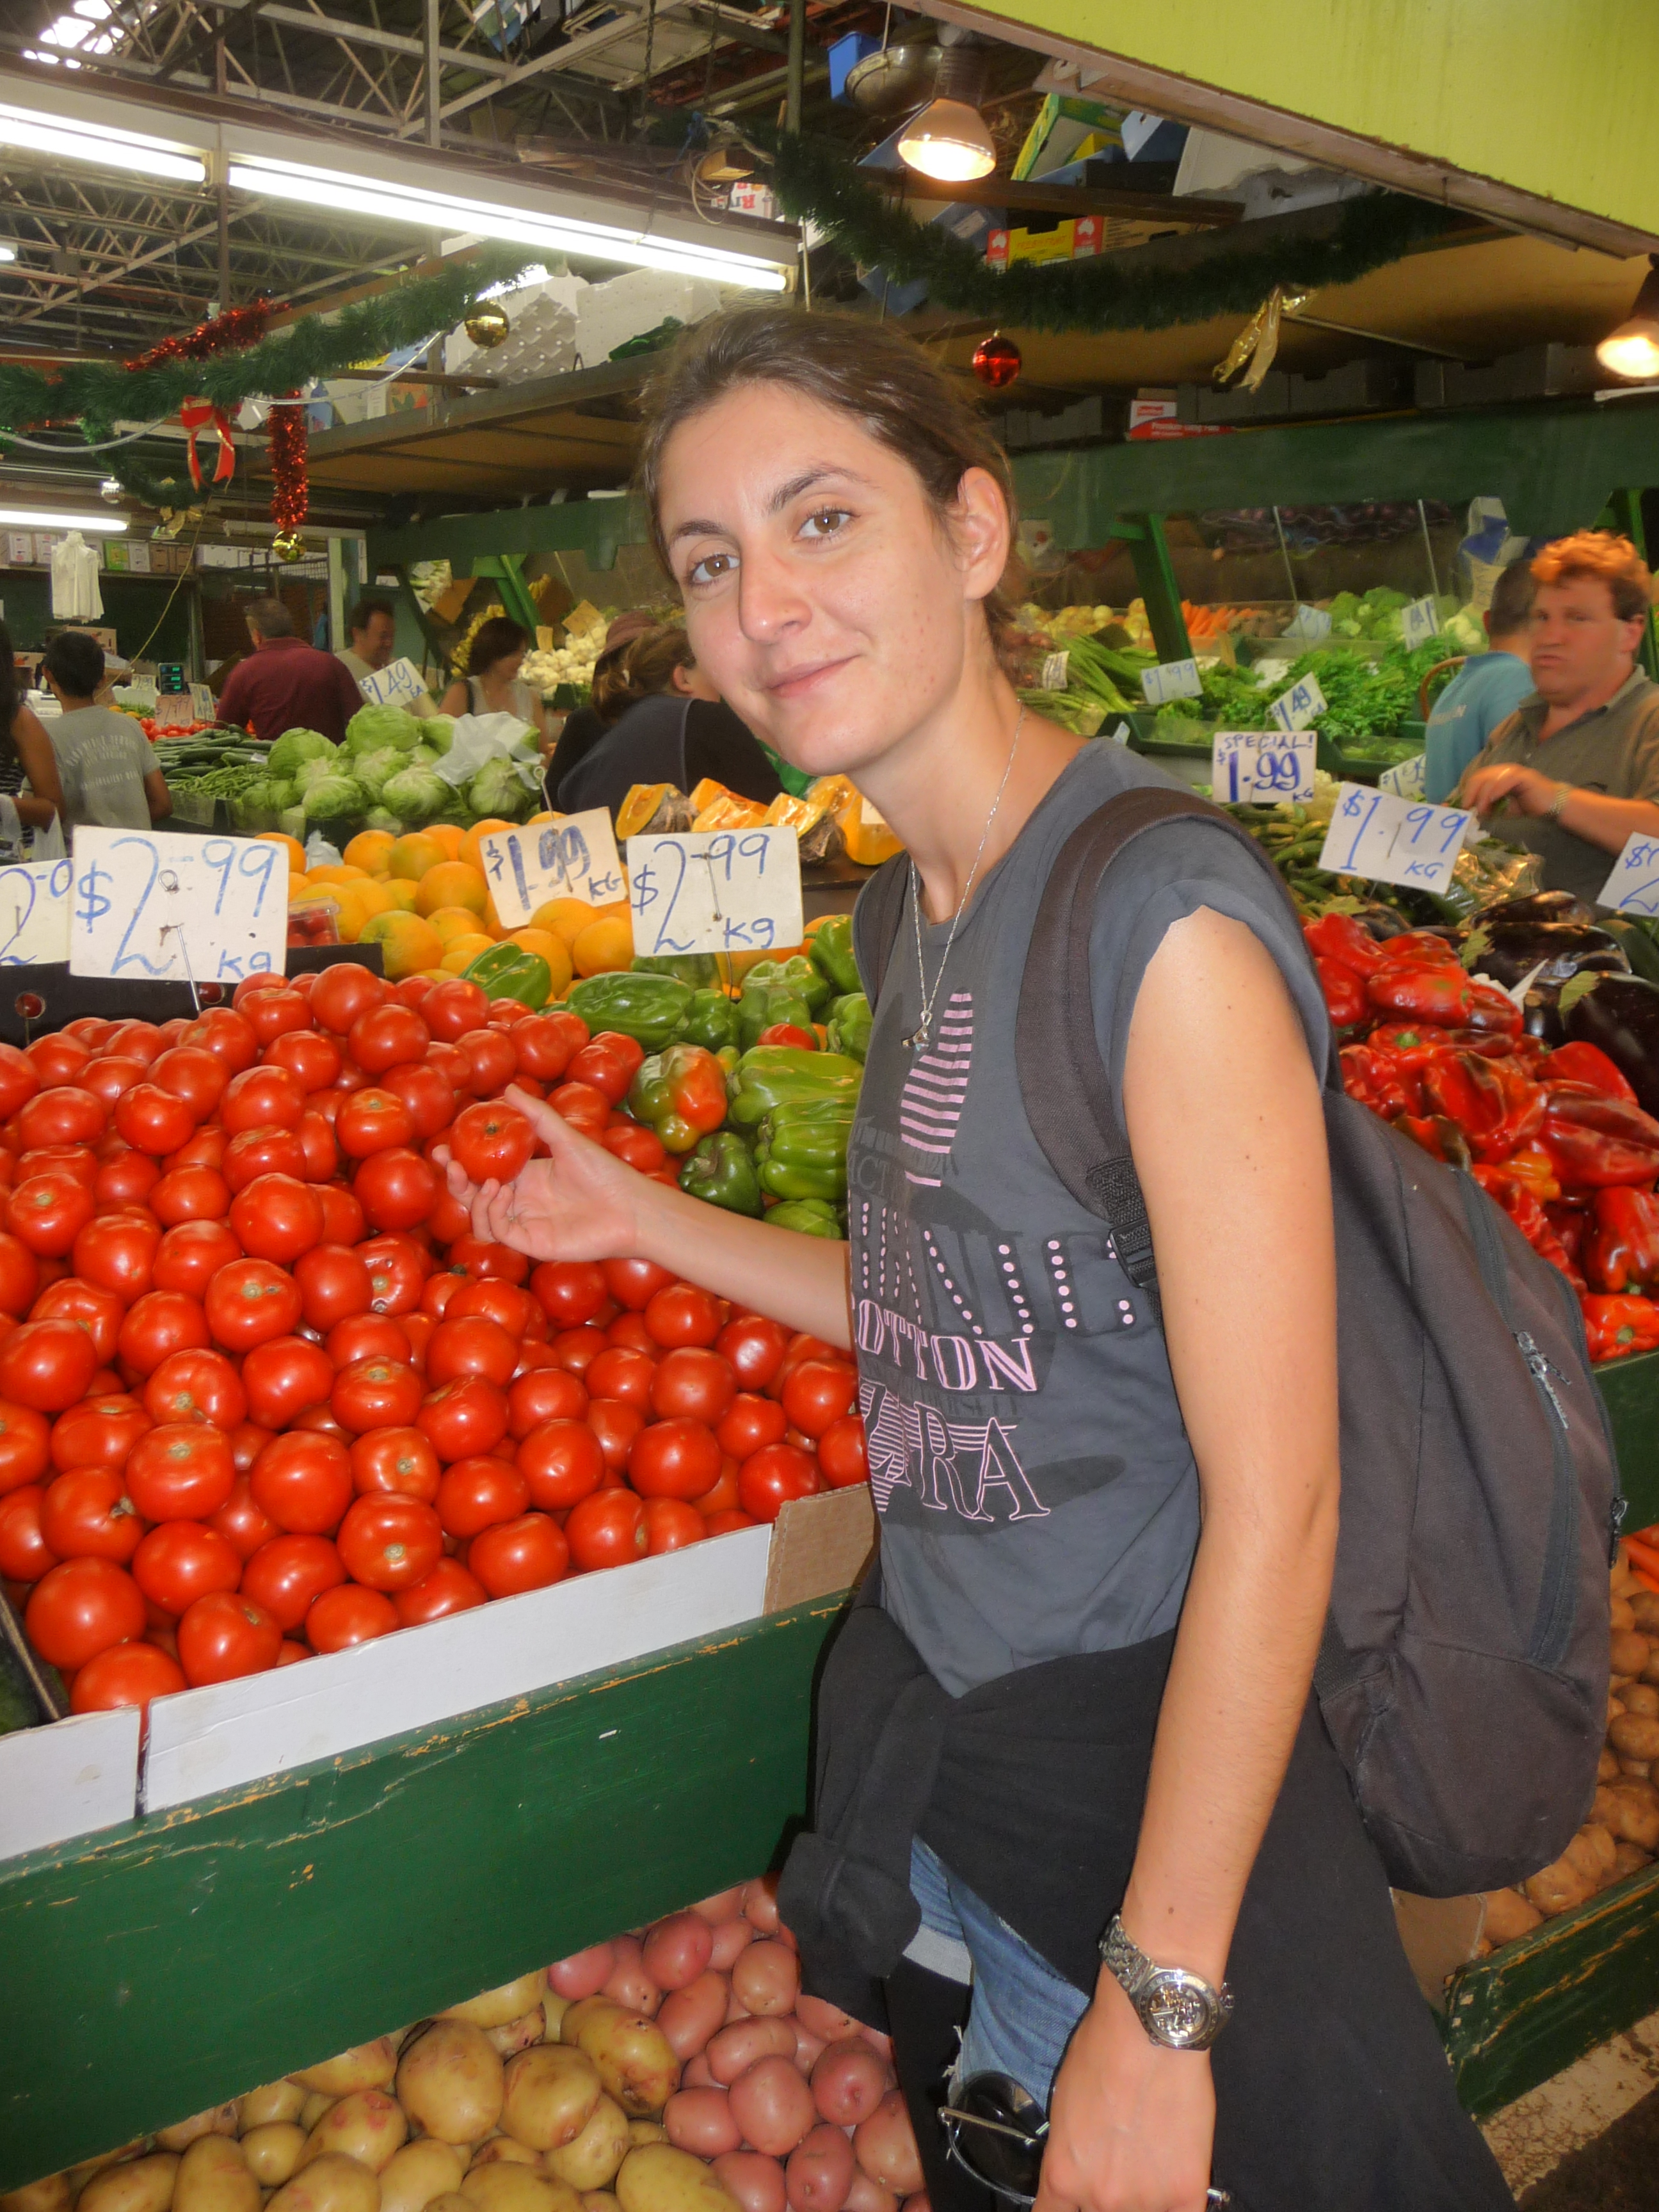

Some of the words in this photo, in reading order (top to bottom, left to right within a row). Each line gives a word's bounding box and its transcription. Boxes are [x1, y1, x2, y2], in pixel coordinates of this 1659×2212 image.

[1224, 733, 1314, 750] SPECIAL!
[1292, 787, 1315, 803] KG
[1340, 789, 1469, 872] $1.99
[1404, 860, 1445, 880] KG
[588, 870, 623, 901] KG
[851, 1295, 1038, 1391] OTTON
